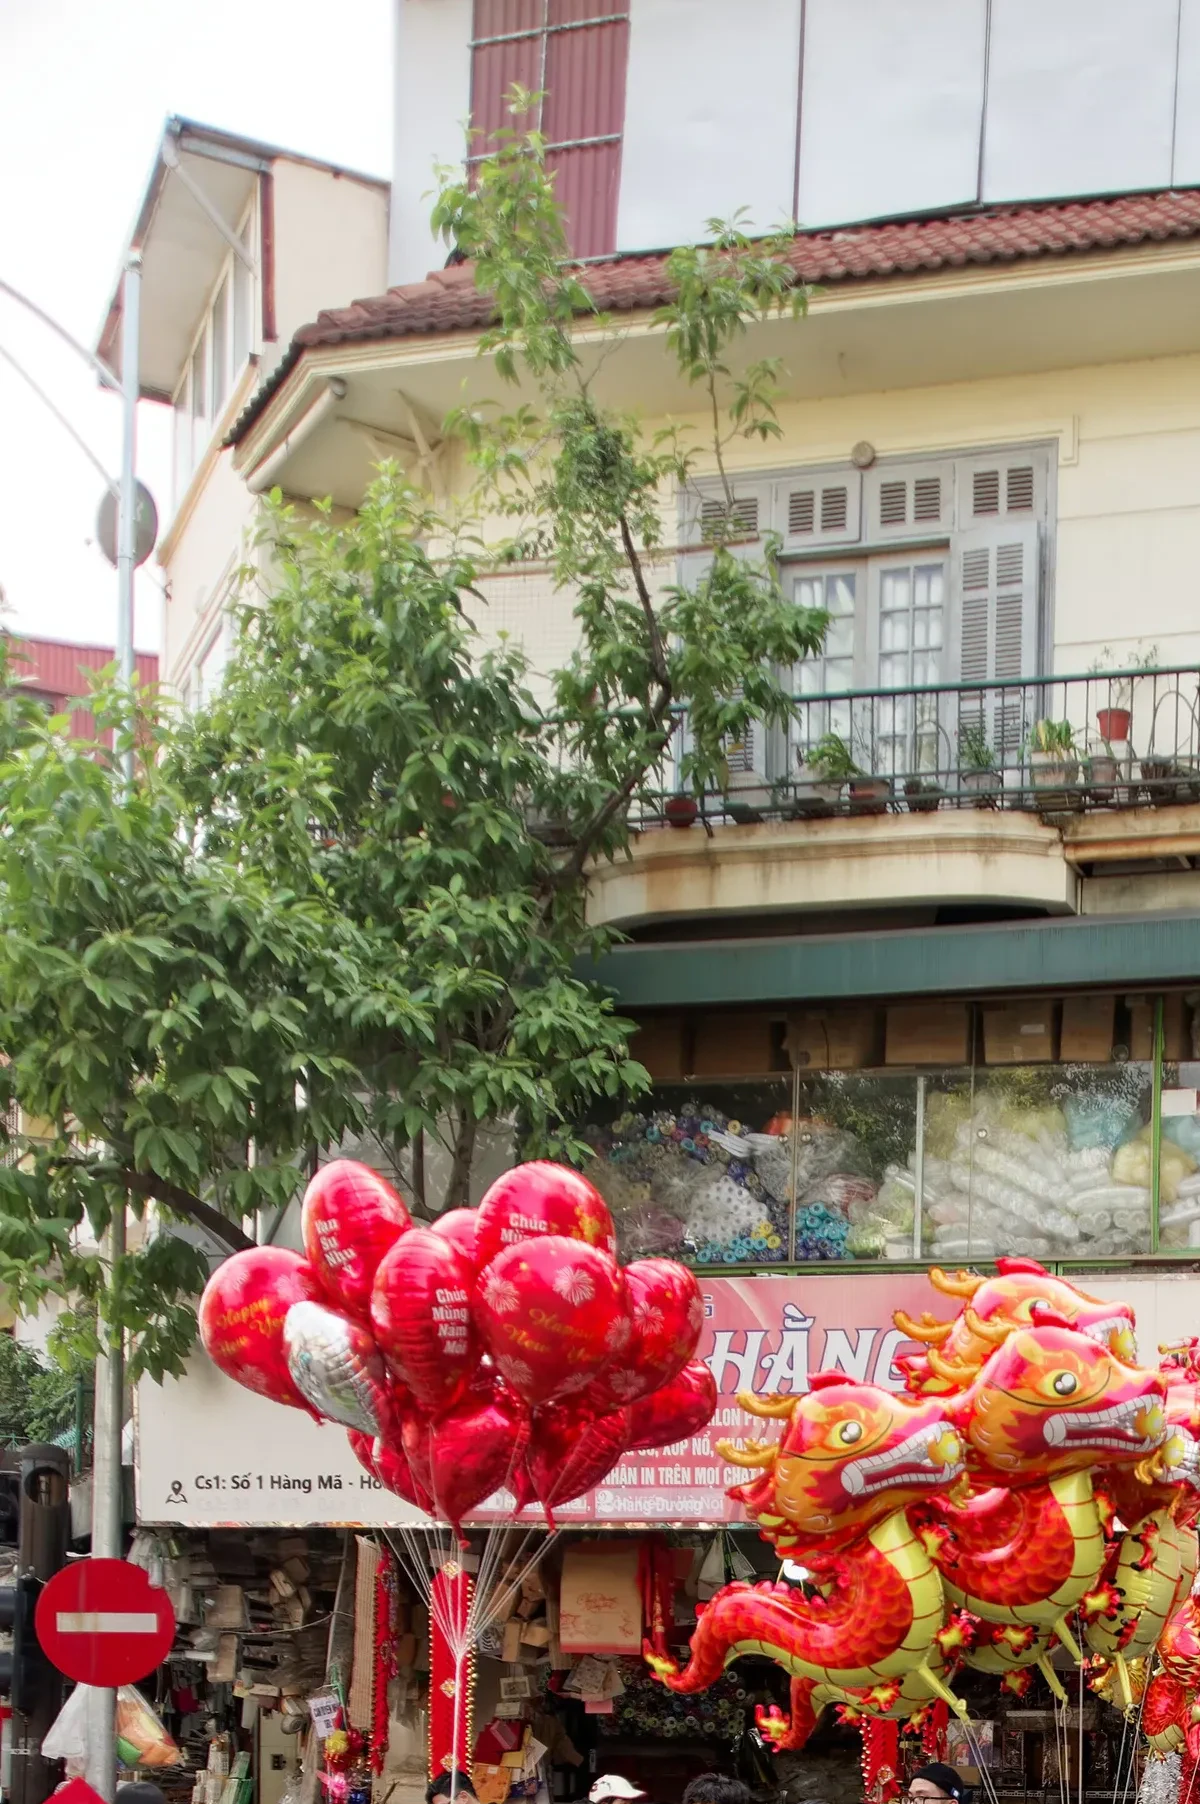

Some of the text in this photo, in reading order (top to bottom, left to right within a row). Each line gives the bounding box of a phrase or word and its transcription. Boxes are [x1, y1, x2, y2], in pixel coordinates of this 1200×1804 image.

[194, 1475, 227, 1490] Cs1:
[230, 1471, 251, 1490] Số
[255, 1475, 263, 1490] 1
[269, 1473, 312, 1493] Hàng
[317, 1474, 343, 1490] Mã
[641, 1466, 655, 1485] IN
[658, 1463, 691, 1485] TRÊN
